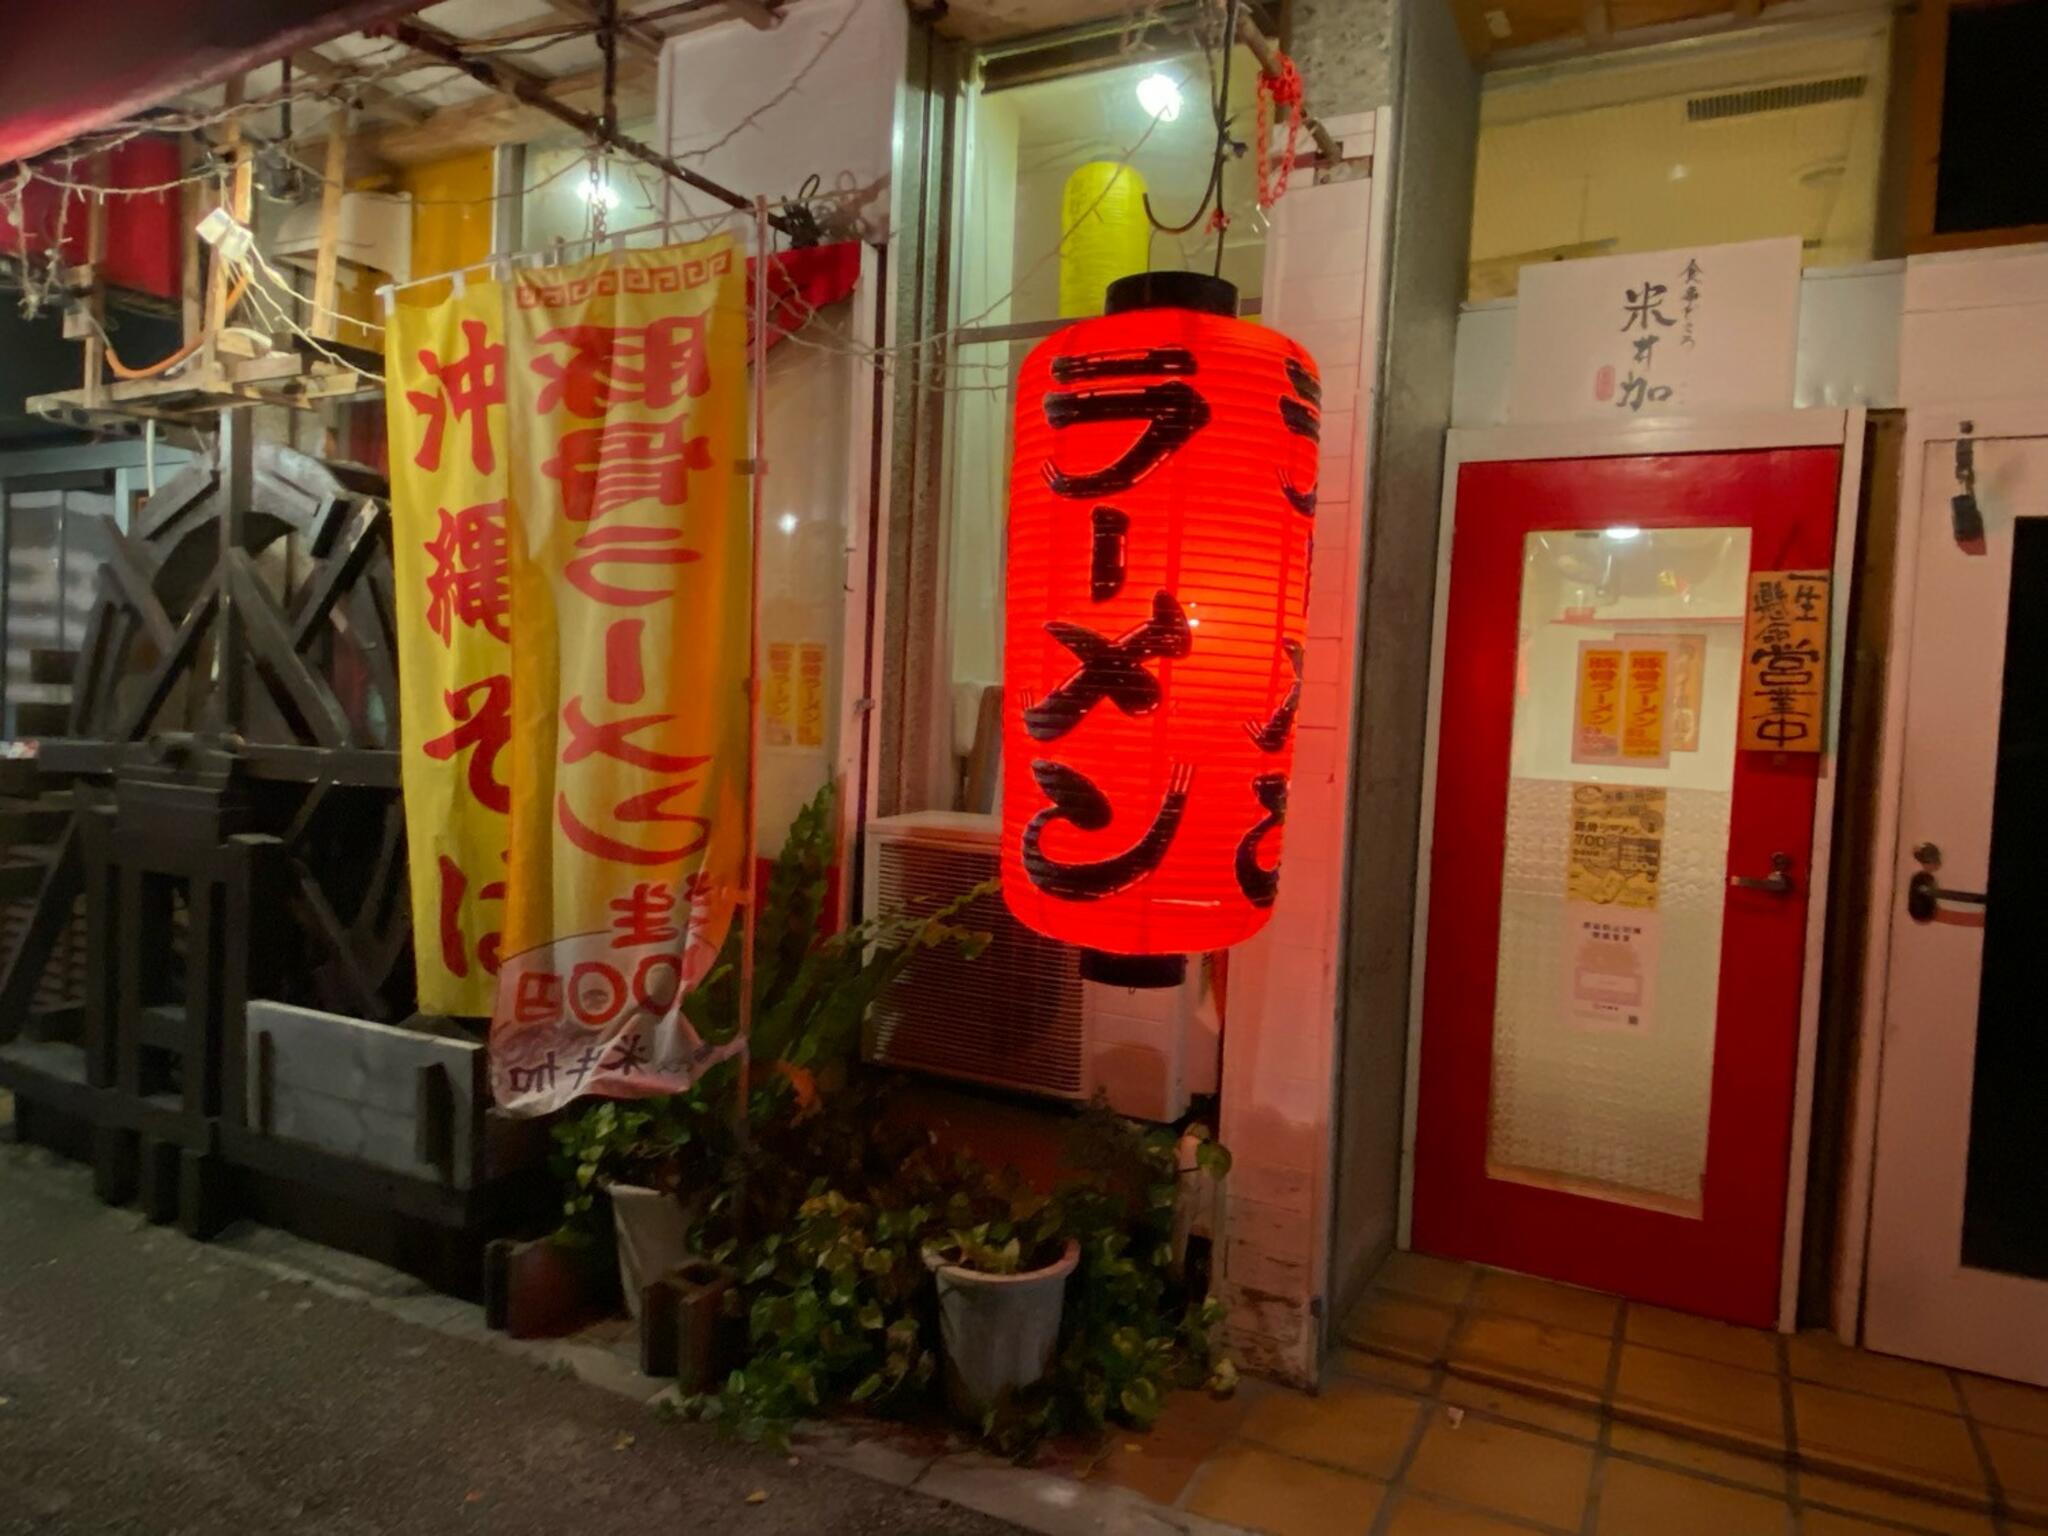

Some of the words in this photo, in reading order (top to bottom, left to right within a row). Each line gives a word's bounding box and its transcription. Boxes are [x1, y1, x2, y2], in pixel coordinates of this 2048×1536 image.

[1616, 281, 1677, 412] 米井加
[1021, 343, 1211, 901] ラーメン
[1751, 638, 1820, 747] 営業中
